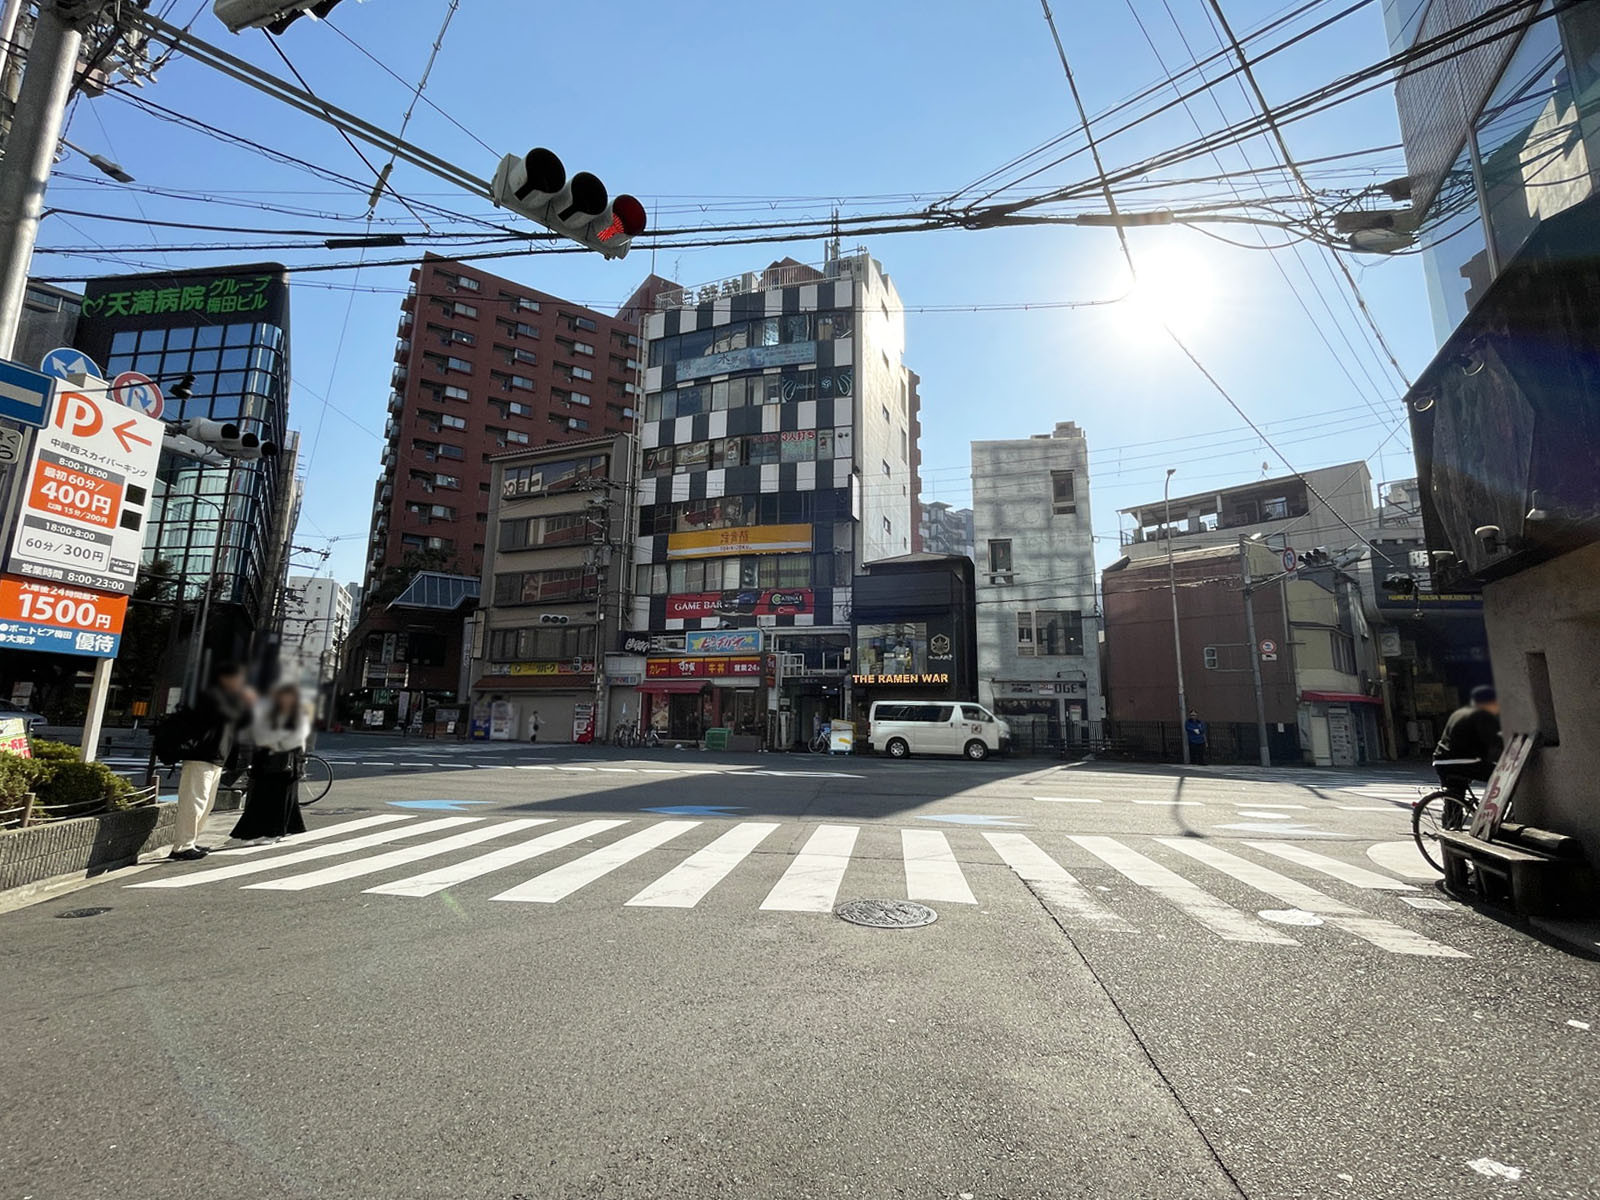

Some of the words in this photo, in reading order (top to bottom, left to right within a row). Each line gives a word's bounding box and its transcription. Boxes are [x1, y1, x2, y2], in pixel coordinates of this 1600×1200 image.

[209, 275, 272, 296] グループ
[105, 286, 206, 317] 天満病院
[206, 293, 268, 314] 梅田ビル
[40, 481, 112, 515] 400円
[67, 572, 125, 591] 8:00-23:00
[19, 593, 112, 629] 1500円
[674, 602, 701, 612] GAME
[703, 601, 723, 611] BAR
[75, 632, 115, 653] 優待
[852, 674, 875, 684] THE
[878, 674, 919, 684] RAMEN
[921, 673, 949, 684] WAR
